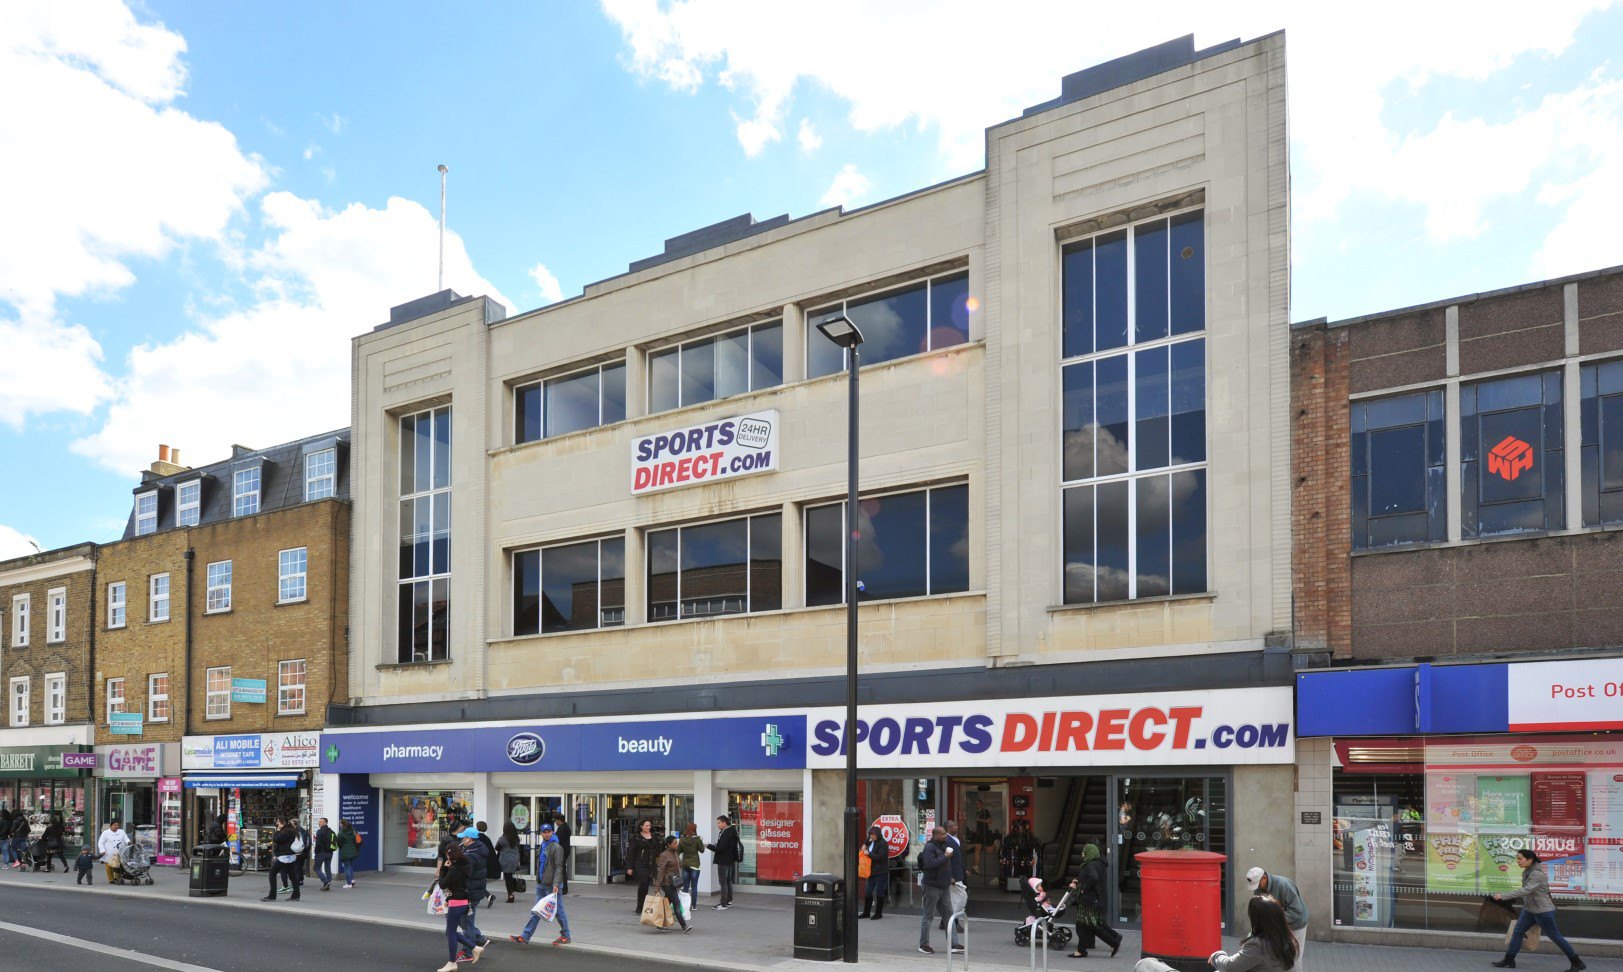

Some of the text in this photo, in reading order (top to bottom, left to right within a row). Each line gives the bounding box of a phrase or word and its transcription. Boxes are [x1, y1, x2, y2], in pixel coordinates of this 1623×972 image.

[741, 423, 768, 436] 24HR
[637, 422, 735, 462] SPORTS
[738, 433, 767, 443] DELIVERY
[1552, 685, 1595, 698] Post
[282, 735, 317, 747] Alico
[811, 714, 994, 756] SPORTS
[215, 739, 260, 749] ALI MOBILE
[510, 739, 537, 757] Boots
[619, 736, 672, 755] beauty
[384, 743, 443, 760] pharmacy
[1552, 749, 1617, 757] postoffice.co.uk
[65, 756, 95, 765] GAME
[109, 748, 155, 771] GAME
[760, 819, 795, 828] designer
[760, 829, 791, 838] glasses
[760, 840, 799, 848] clearance
